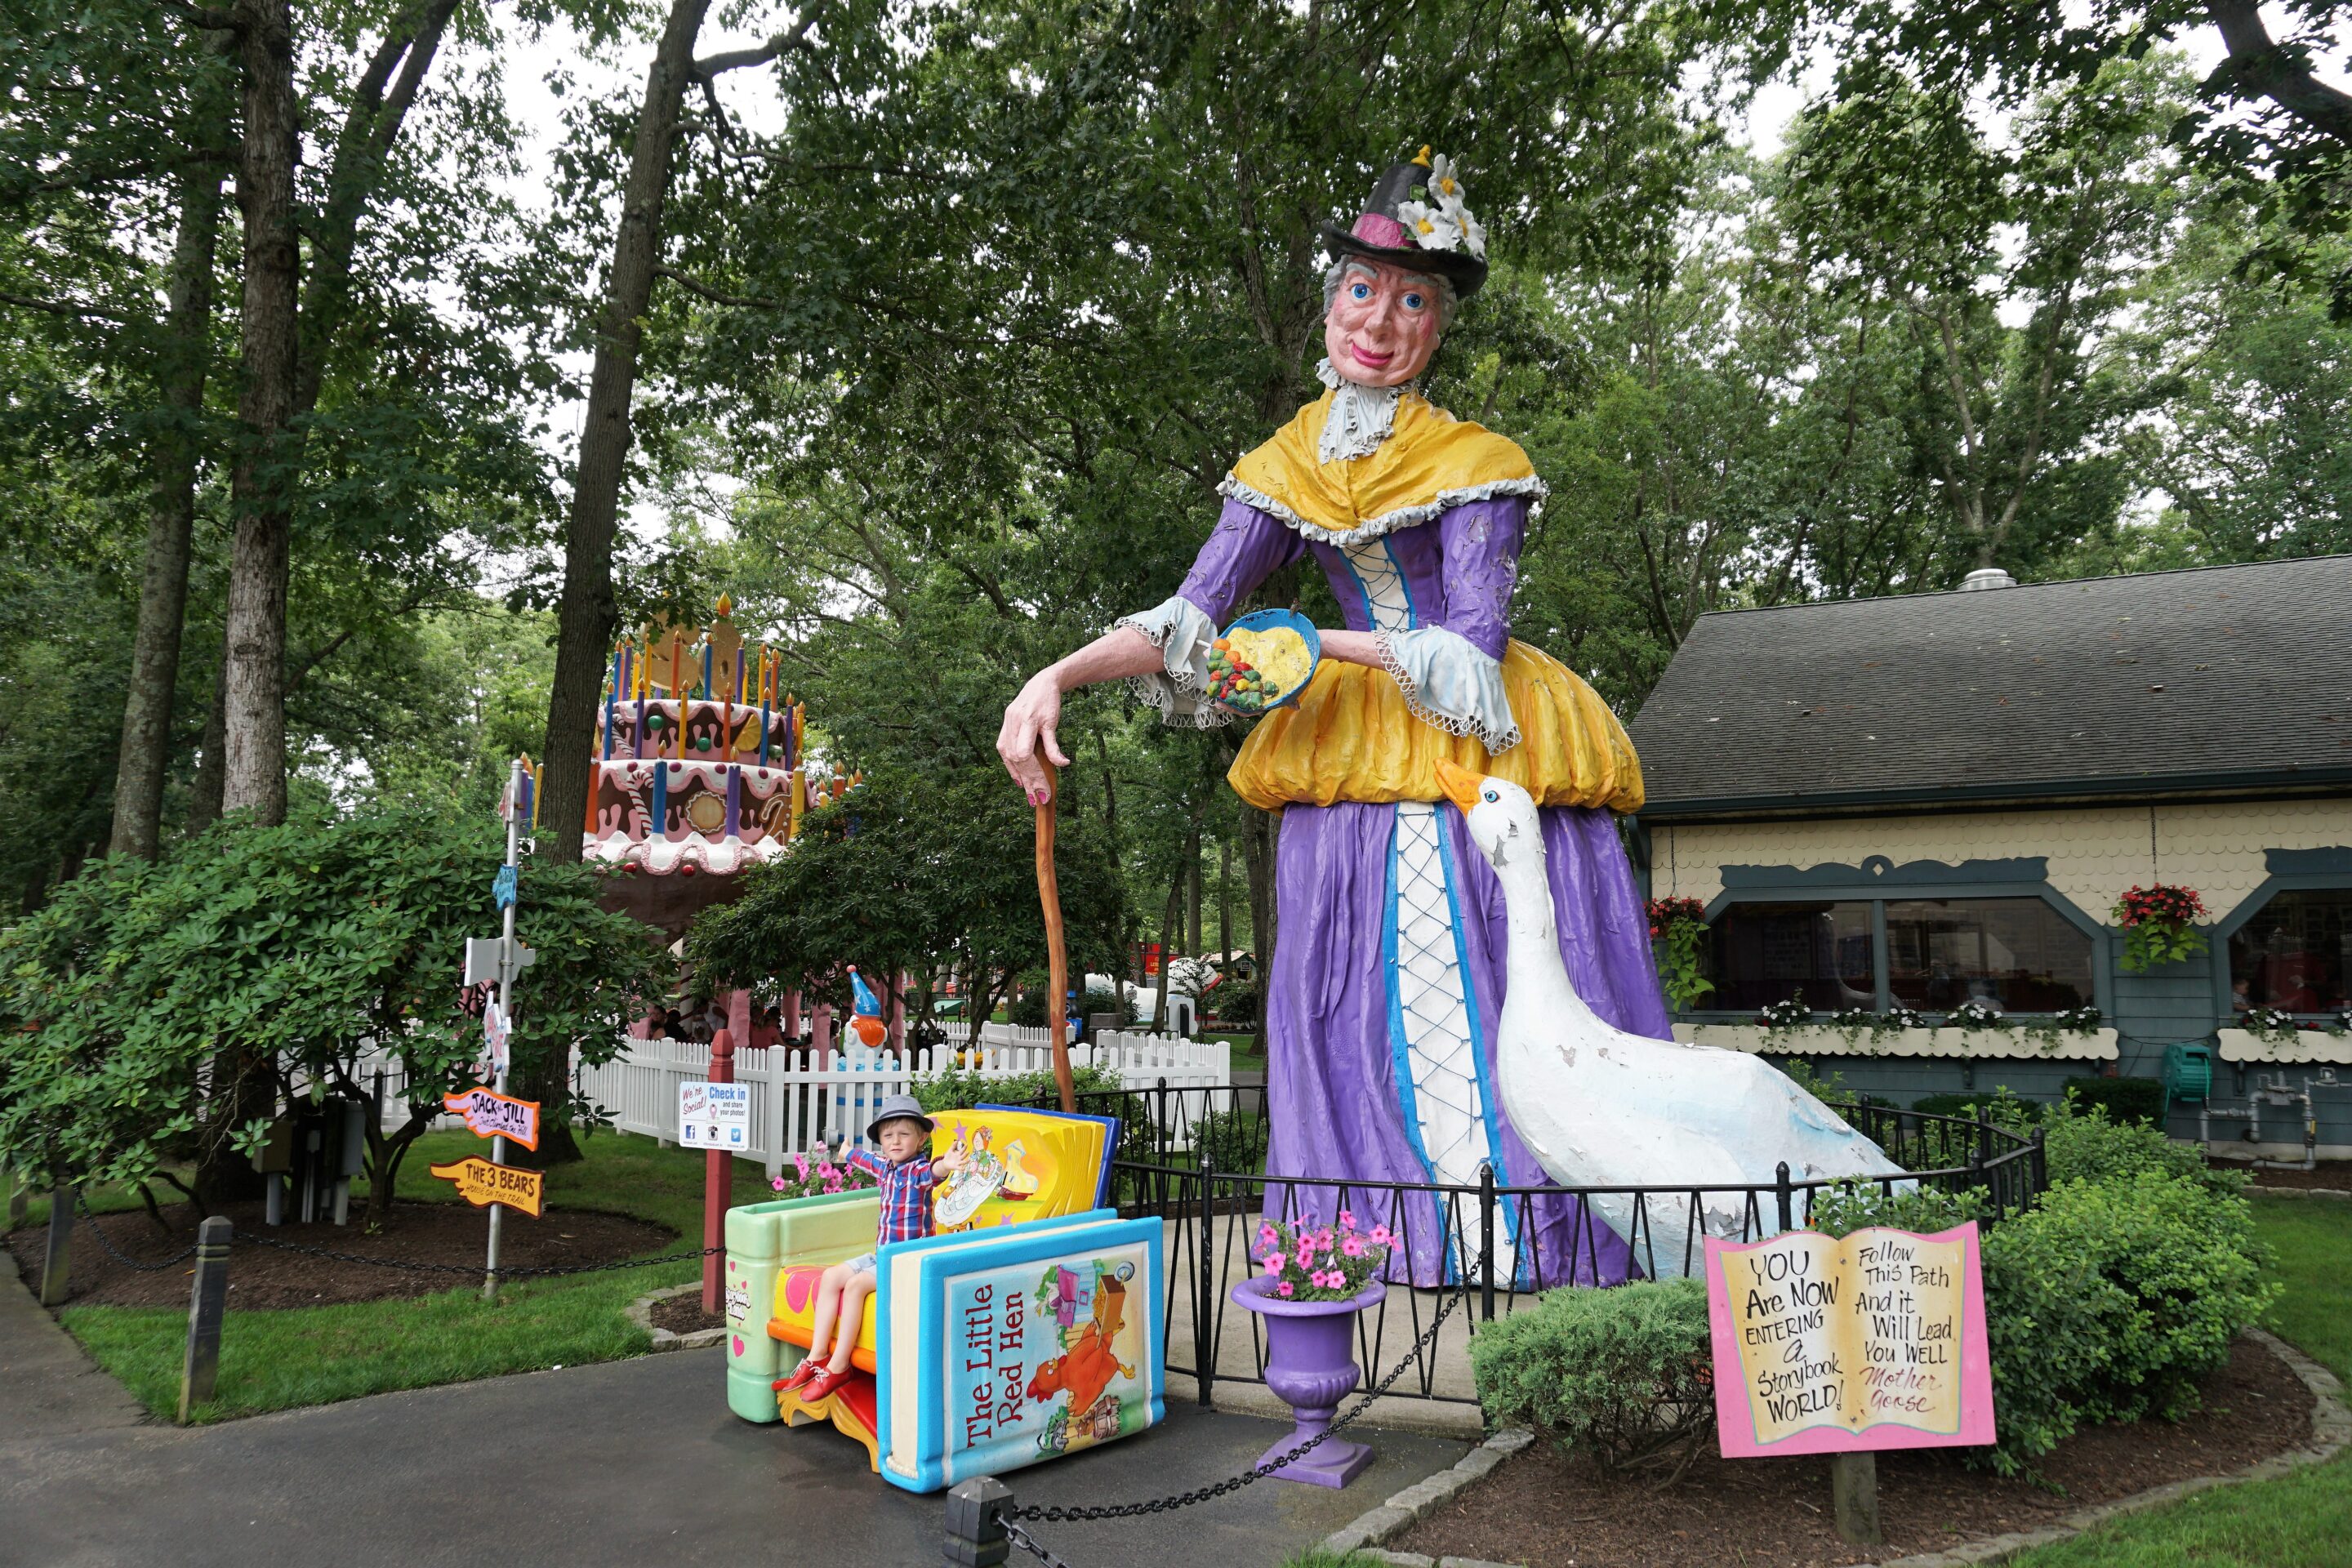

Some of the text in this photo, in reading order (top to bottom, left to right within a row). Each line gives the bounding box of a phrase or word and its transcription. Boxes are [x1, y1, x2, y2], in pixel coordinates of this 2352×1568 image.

[683, 1085, 702, 1101] We're
[683, 1095, 707, 1116] Social!
[709, 1086, 746, 1100] Check in
[472, 1094, 497, 1115] JACK
[503, 1102, 525, 1125] JILL
[466, 1164, 534, 1197] THE 3 BEARS
[466, 1184, 484, 1195] HOUSE
[494, 1191, 507, 1200] THE
[507, 1194, 525, 1205] TRAIL
[1750, 1250, 1810, 1285] YOU
[1859, 1241, 1915, 1267] Follow
[1864, 1264, 1949, 1289] This Path
[1745, 1276, 1840, 1319] Are NOW
[1855, 1290, 1916, 1315] And it
[1746, 1308, 1824, 1345] ENTERING
[1873, 1314, 1953, 1342] Will Lead
[965, 1284, 994, 1448] The Little
[997, 1291, 1024, 1428] Red Hen
[1864, 1340, 1948, 1365] You WELL
[1757, 1352, 1843, 1397] Storybook
[1859, 1366, 1943, 1391] Mother
[1766, 1379, 1845, 1423] WORLD!
